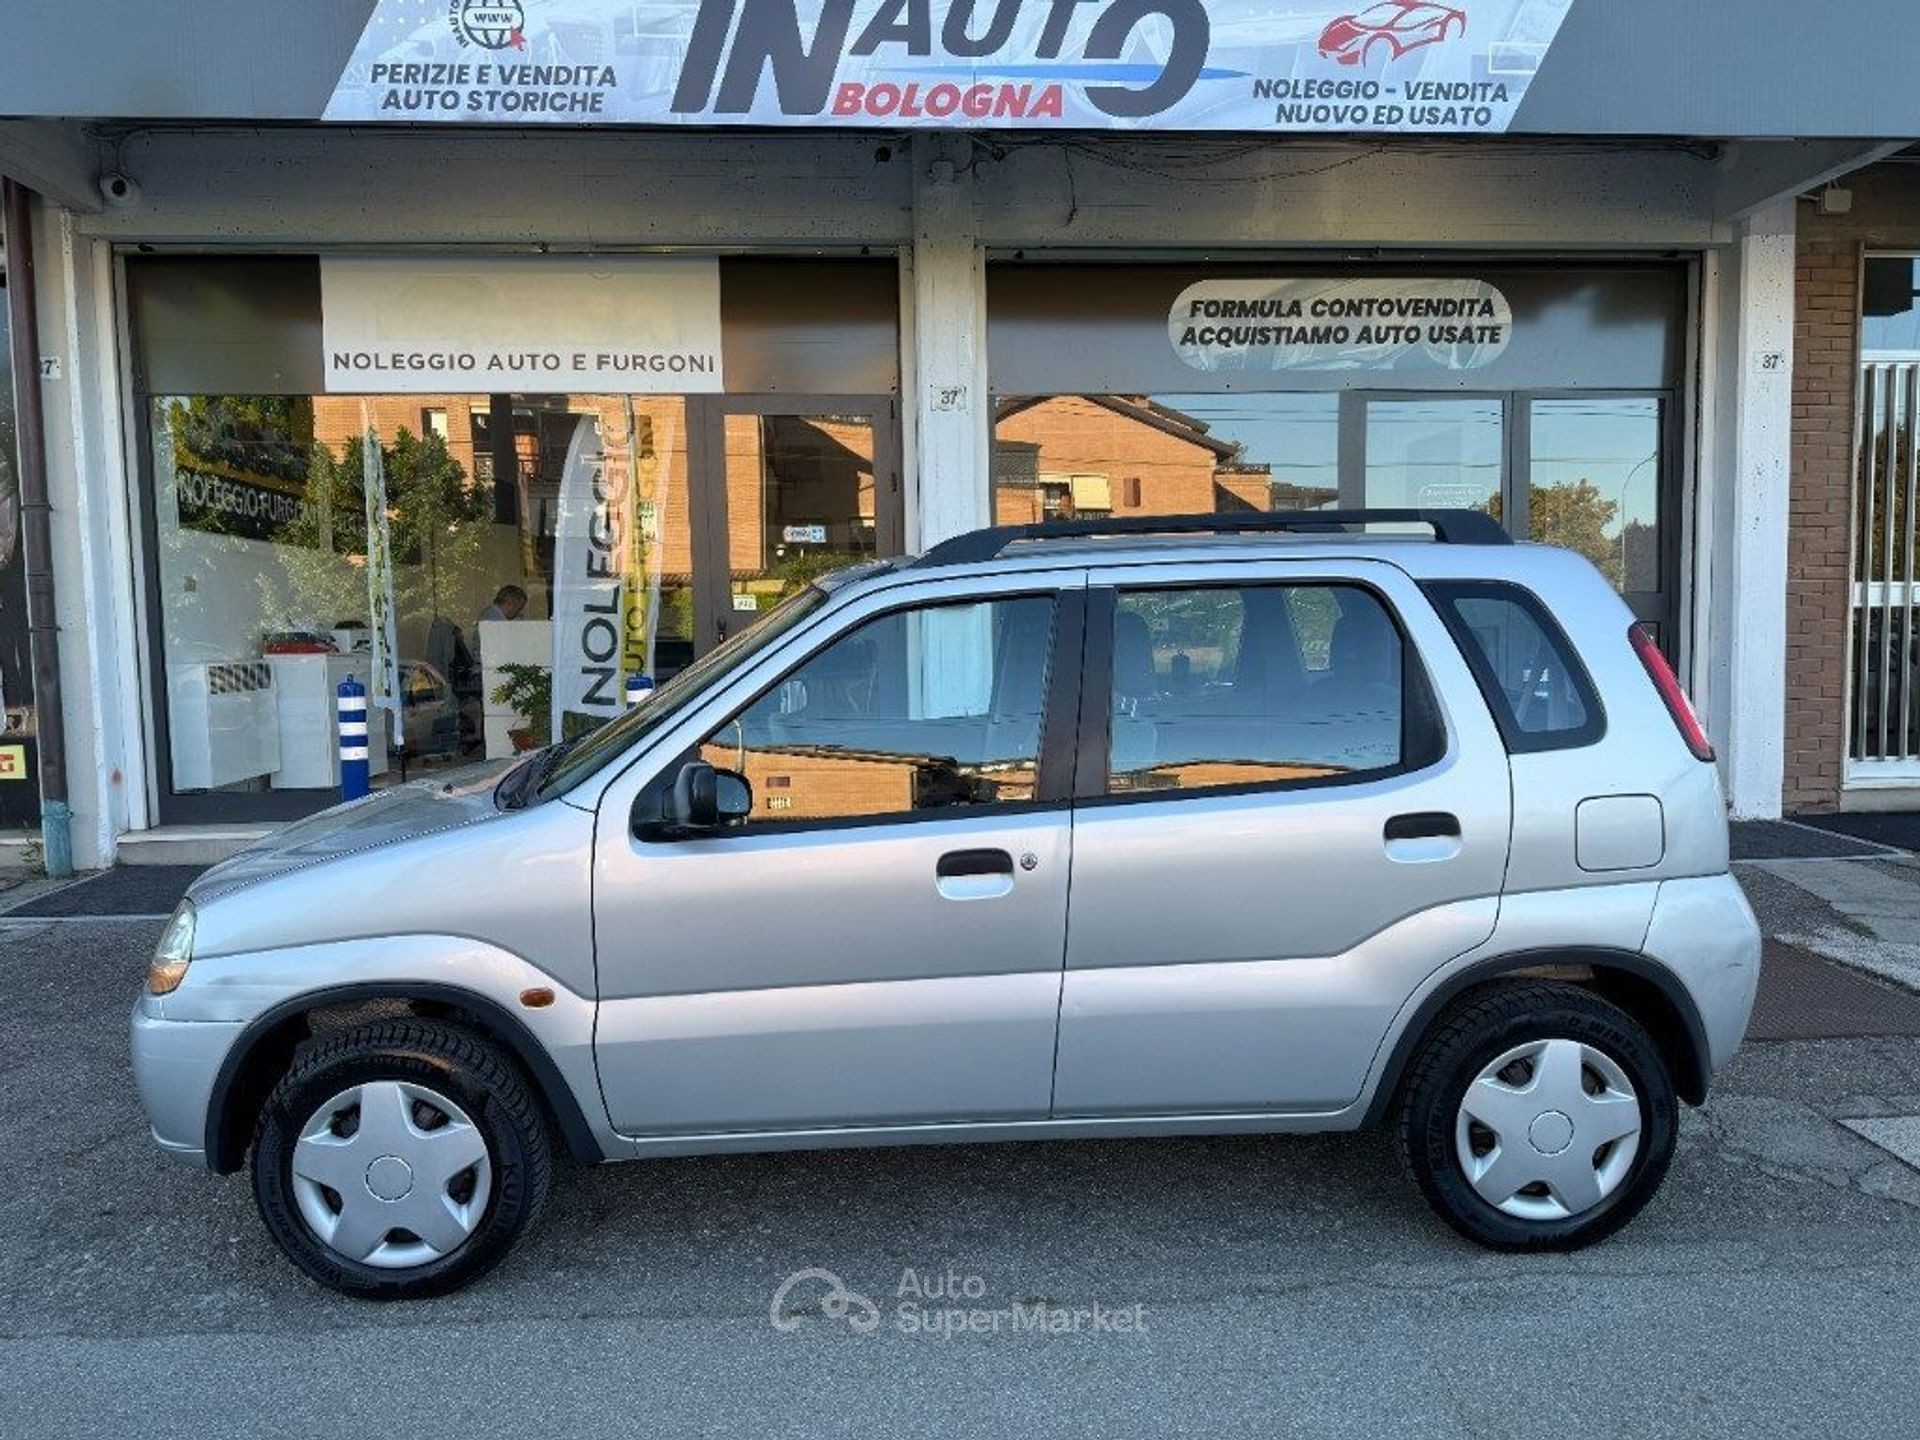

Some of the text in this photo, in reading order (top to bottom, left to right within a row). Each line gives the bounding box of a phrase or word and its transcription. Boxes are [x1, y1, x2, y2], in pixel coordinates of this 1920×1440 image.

[371, 64, 617, 87] PERIZIE E VENDITA
[382, 89, 604, 112] AUTO STORICHE
[832, 83, 1063, 118] BOLOGNA
[1253, 79, 1380, 100] NOLEGGIO
[1404, 82, 1509, 102] VENDITA
[1275, 104, 1492, 126] NUOVO ED USATO
[1190, 299, 1496, 318] FORMULA CONTOVENDITA
[1180, 326, 1502, 347] ACQUISTIAMO AUTO USATE
[333, 352, 715, 373] NOLEGGIO AUTO E FURGONI
